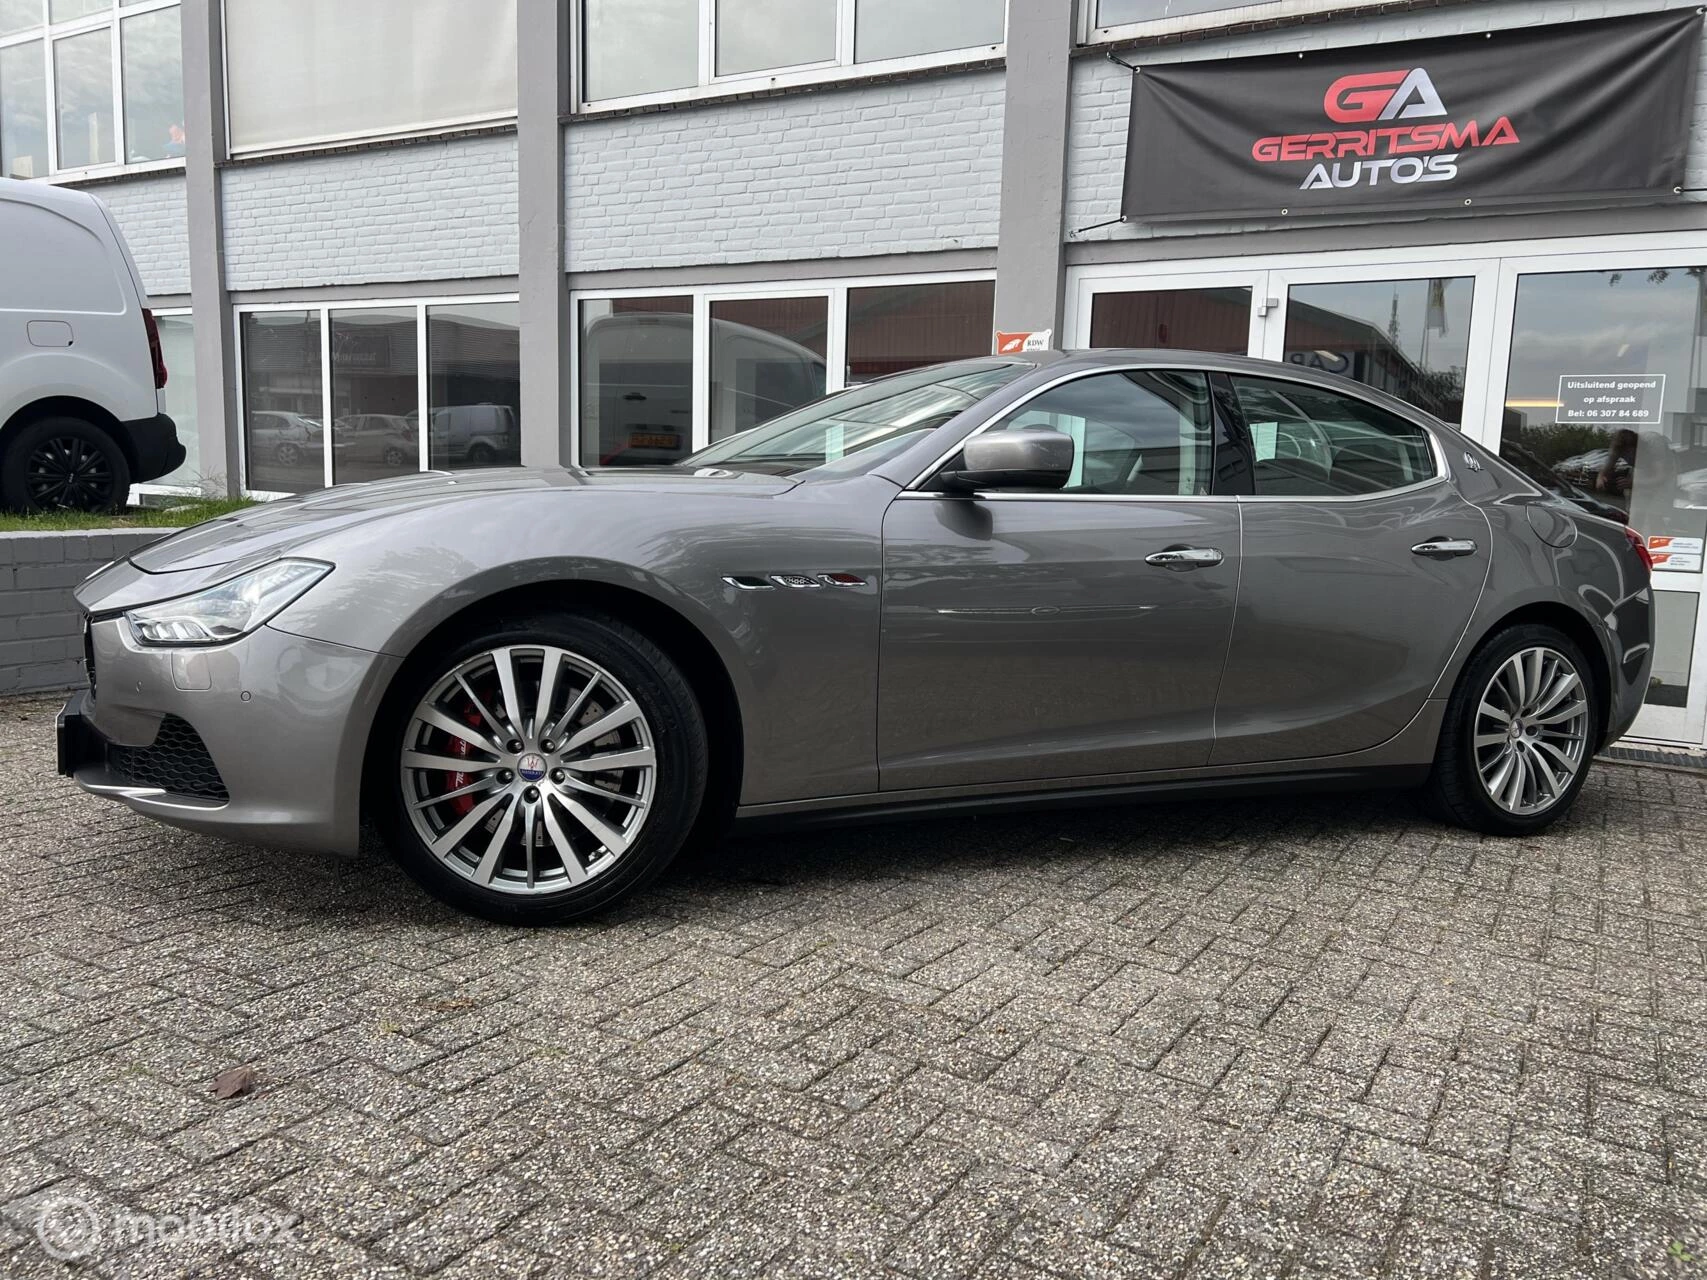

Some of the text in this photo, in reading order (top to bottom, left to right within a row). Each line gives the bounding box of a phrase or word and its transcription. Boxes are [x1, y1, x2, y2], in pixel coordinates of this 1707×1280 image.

[1324, 67, 1448, 123] GA
[1251, 116, 1520, 161] GERRITSMA
[1299, 153, 1459, 189] AUTO'S
[1567, 380, 1656, 390] Uitsluitend geopend
[1583, 395, 1636, 404] op afspraak
[1567, 409, 1649, 417] Bel: 06 307 84 689
